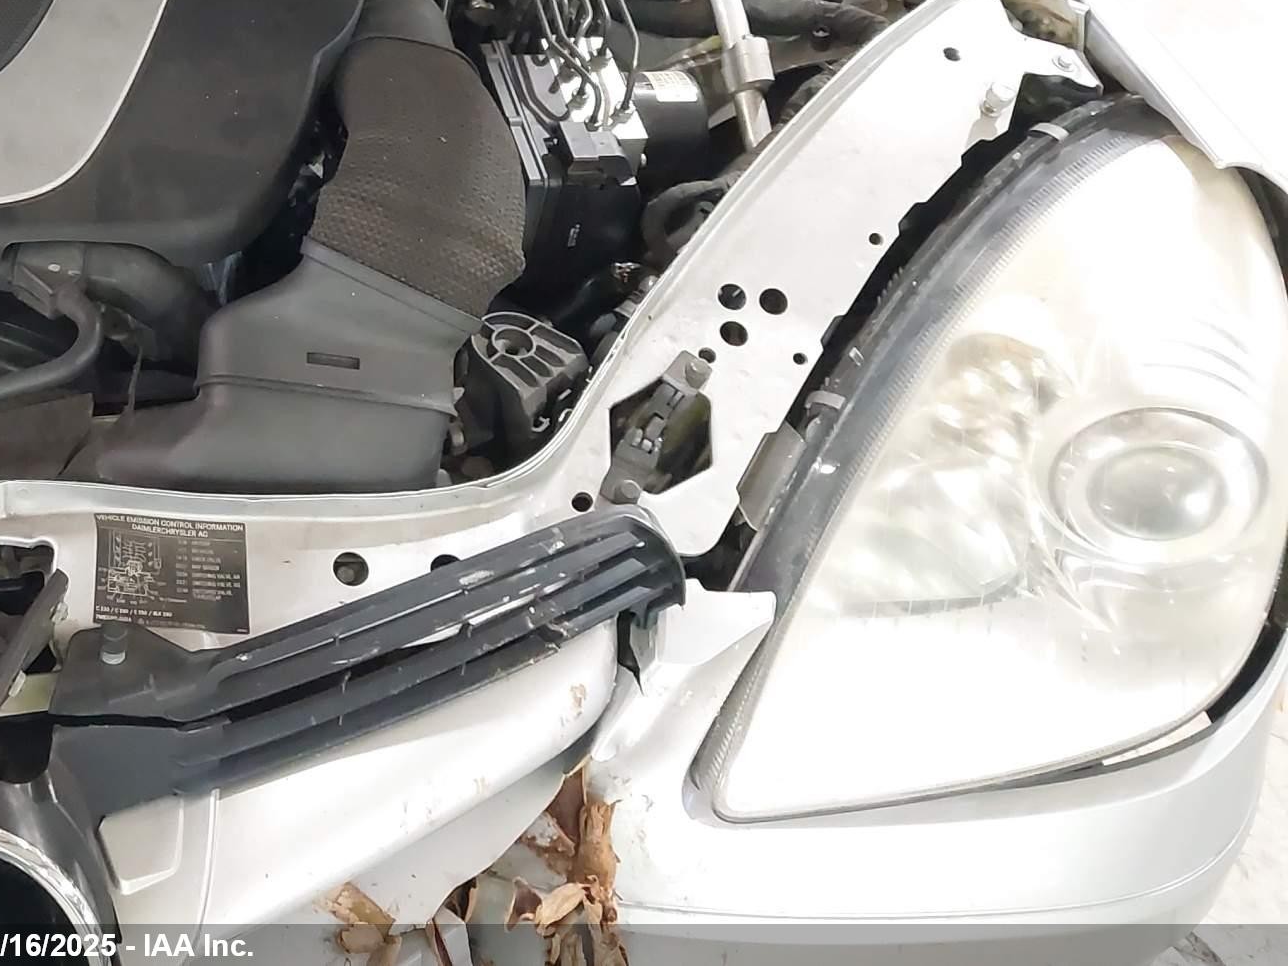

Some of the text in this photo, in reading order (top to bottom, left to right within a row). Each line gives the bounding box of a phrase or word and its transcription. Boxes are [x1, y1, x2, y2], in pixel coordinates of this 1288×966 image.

[127, 516, 159, 527] EMISSION
[161, 519, 192, 529] CONTROL
[195, 521, 244, 532] INFORMATION
[132, 523, 208, 538] DAIMLERCHRYSLER AG
